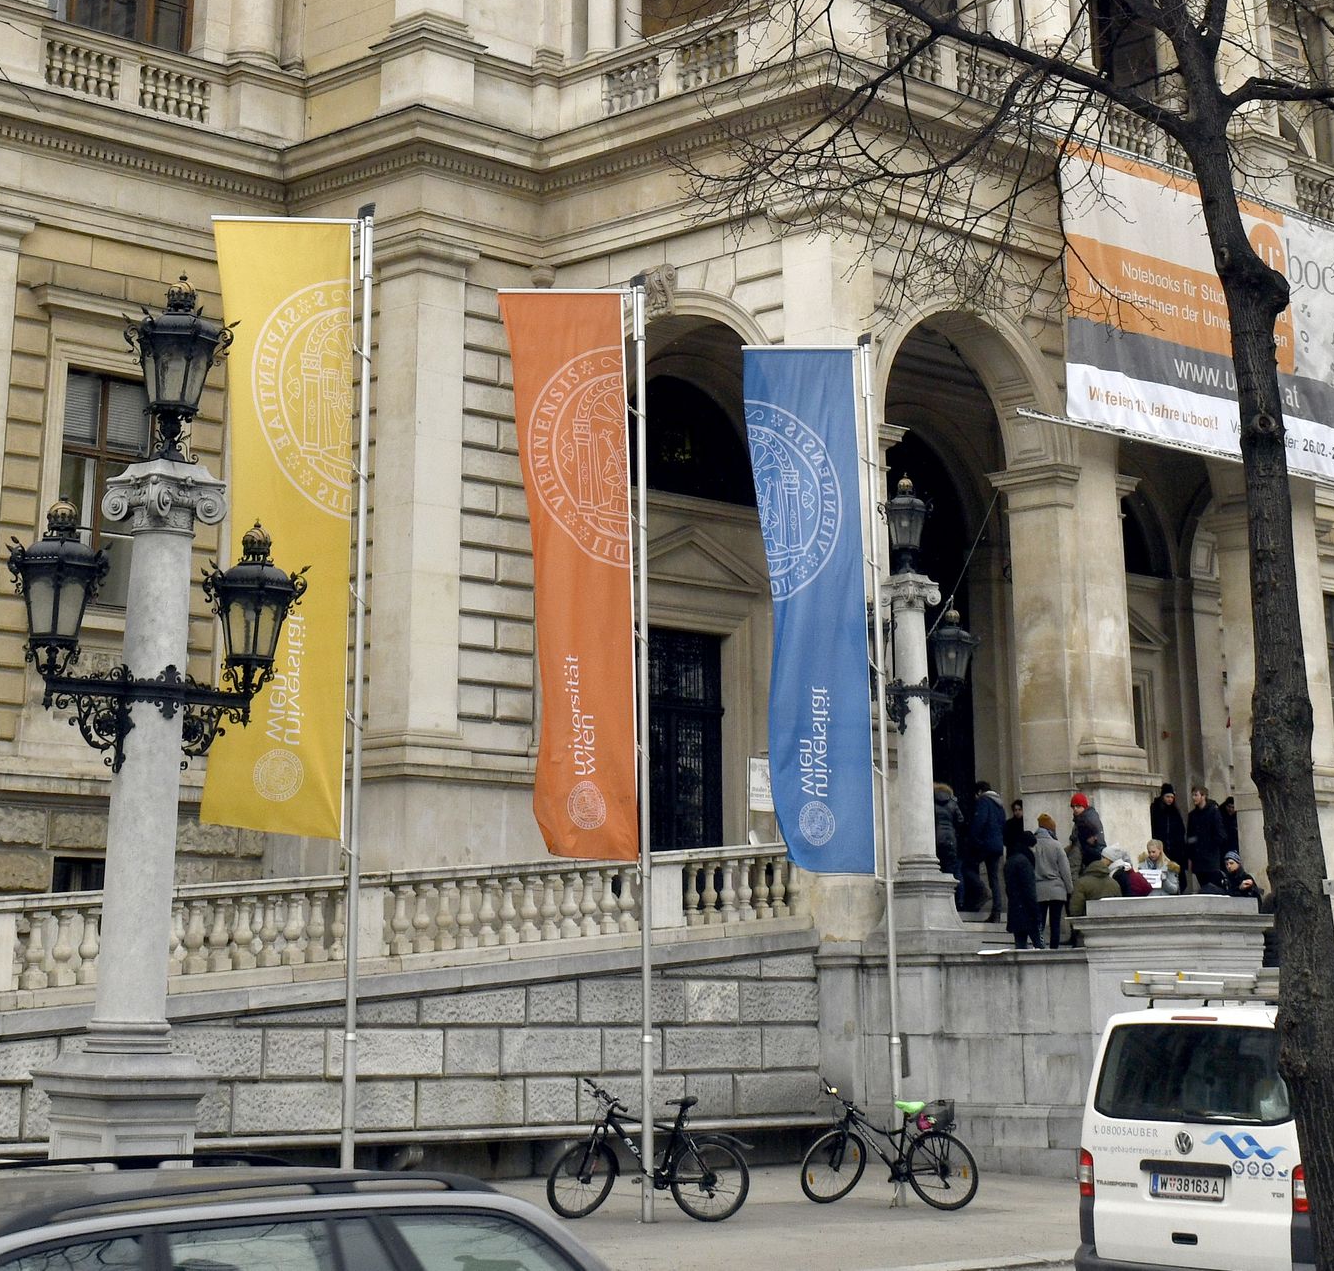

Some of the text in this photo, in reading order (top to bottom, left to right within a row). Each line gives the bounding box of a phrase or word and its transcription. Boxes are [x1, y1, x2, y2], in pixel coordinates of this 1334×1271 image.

[1120, 260, 1181, 293] Notebooks
[1183, 278, 1198, 298] für
[1181, 304, 1199, 323] der
[1149, 402, 1179, 421] Jahre
[533, 366, 581, 512] VIENNENSIS
[564, 653, 587, 776] universität
[581, 714, 597, 775] wien
[1100, 1125, 1159, 1138] 0800SAUBER
[1096, 1178, 1138, 1188] TRANSPORTER
[1160, 1176, 1168, 1190] W
[1176, 1177, 1210, 1194] 38163
